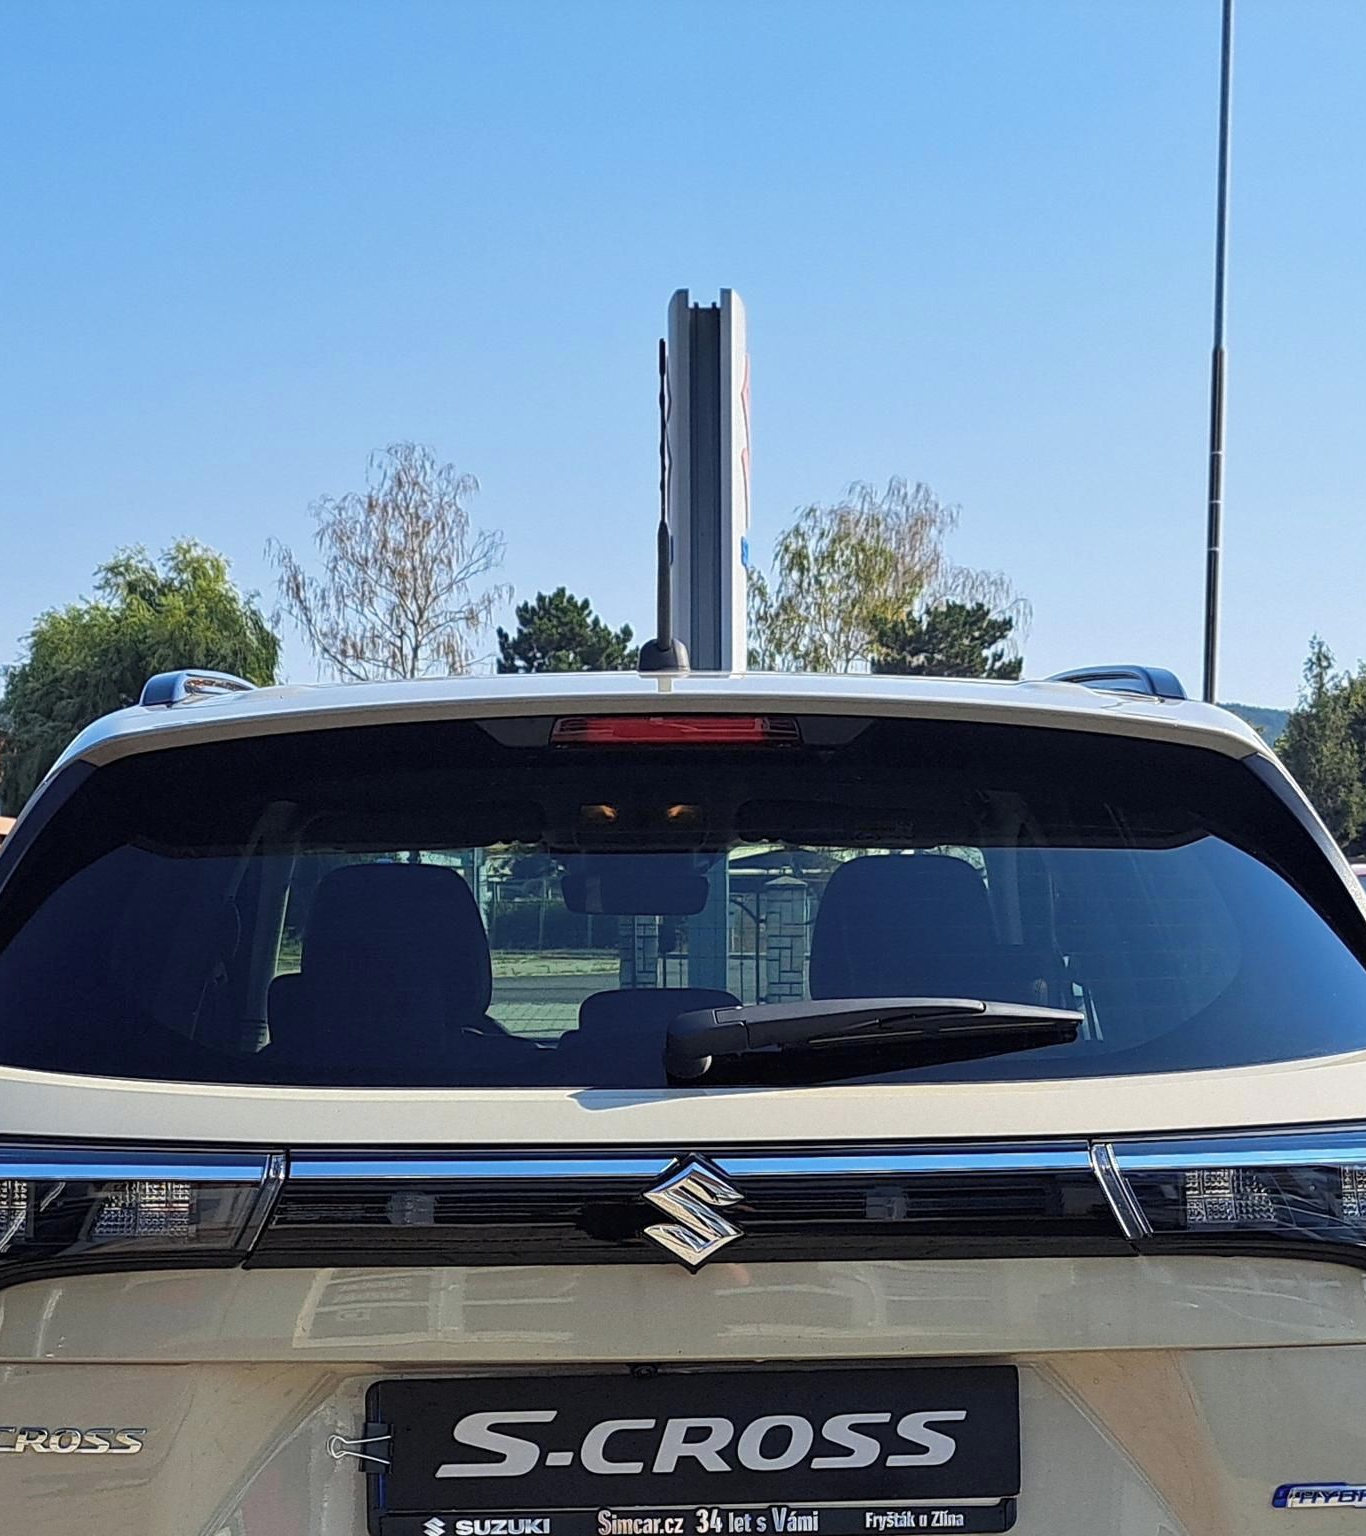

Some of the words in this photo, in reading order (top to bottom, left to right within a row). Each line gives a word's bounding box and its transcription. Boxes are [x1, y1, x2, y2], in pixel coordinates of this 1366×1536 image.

[434, 1409, 967, 1478] S-CROSS
[455, 1518, 551, 1536] SUZUKI
[597, 1509, 684, 1536] Simcar.cz
[695, 1508, 723, 1534] 34
[728, 1511, 752, 1533] let
[756, 1515, 767, 1533] s
[771, 1507, 819, 1533] Vámi
[865, 1511, 916, 1531] Fryšták
[919, 1515, 928, 1528] u
[930, 1510, 964, 1528] Zlína
